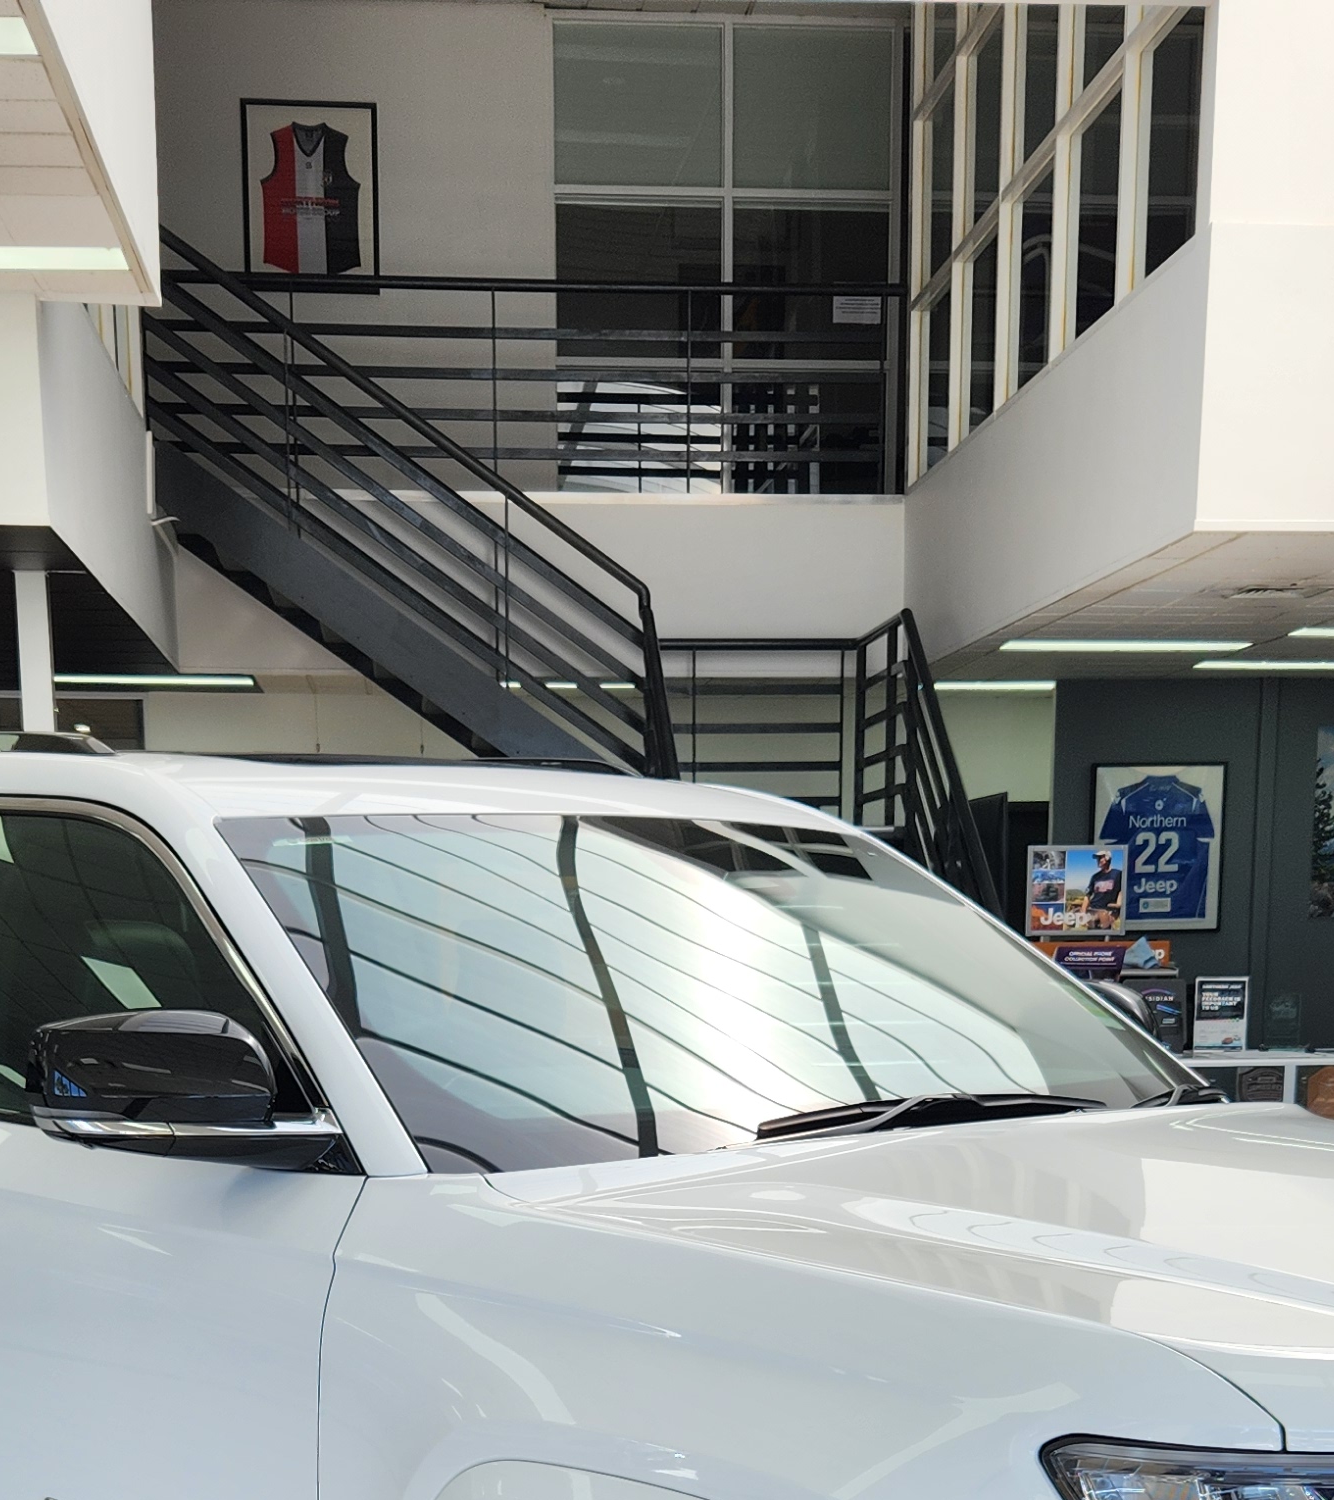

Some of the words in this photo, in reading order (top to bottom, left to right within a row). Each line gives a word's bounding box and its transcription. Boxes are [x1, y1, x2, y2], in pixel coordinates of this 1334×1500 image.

[1129, 814, 1187, 829] Northern
[1134, 831, 1179, 874] 22
[1133, 878, 1178, 895] Jeep
[1040, 907, 1086, 927] Jeep
